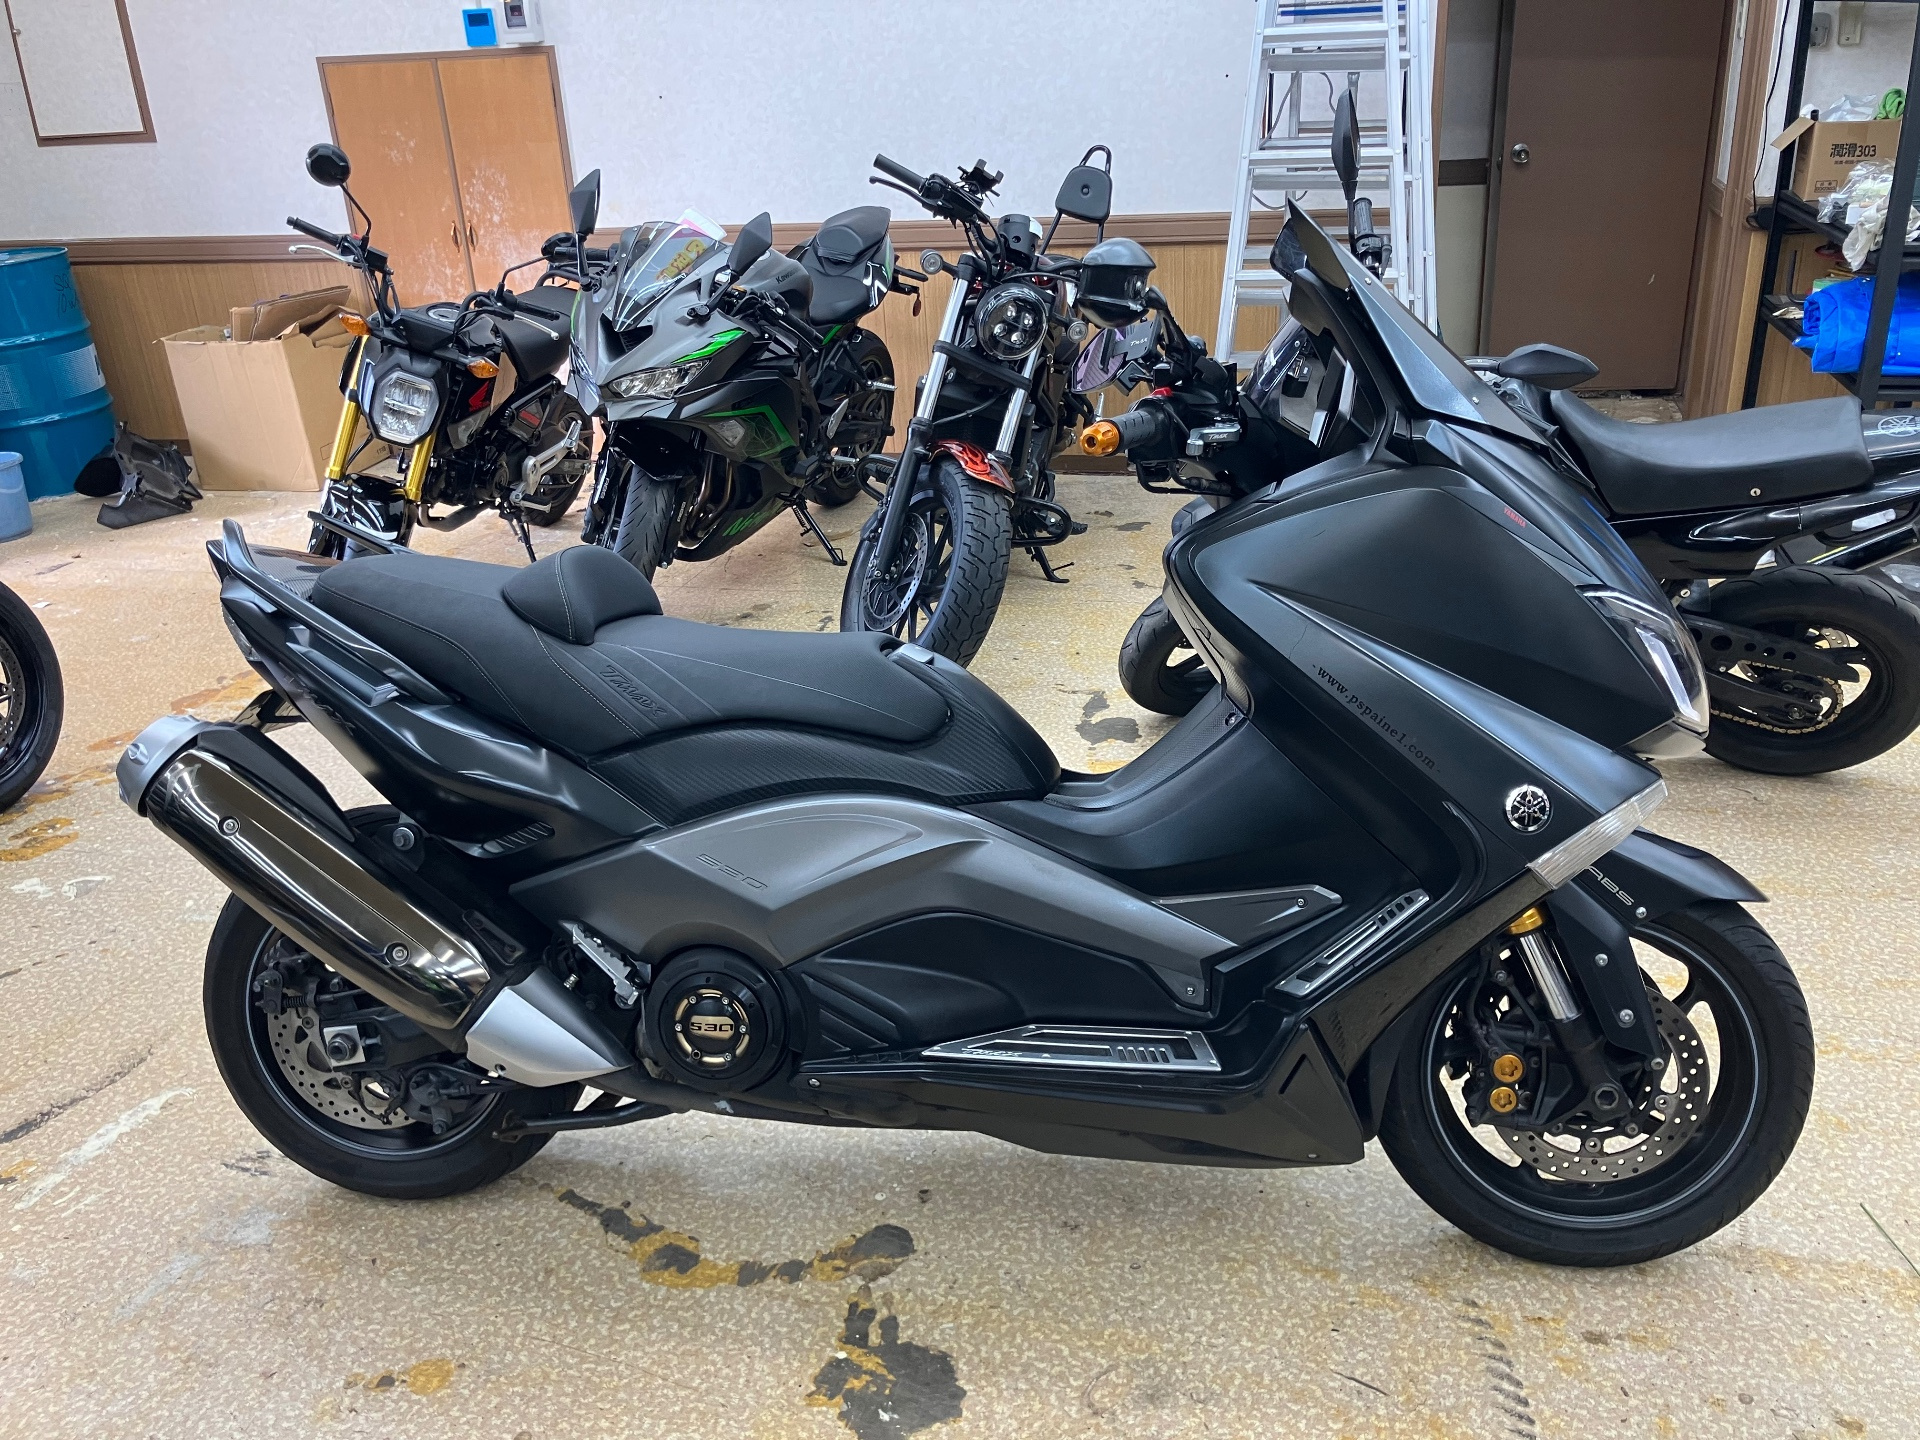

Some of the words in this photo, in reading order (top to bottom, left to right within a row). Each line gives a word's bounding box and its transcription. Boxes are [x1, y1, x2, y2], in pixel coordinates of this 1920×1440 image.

[695, 853, 769, 890] 530
[1586, 865, 1635, 906] ABS
[690, 1021, 734, 1032] 530
